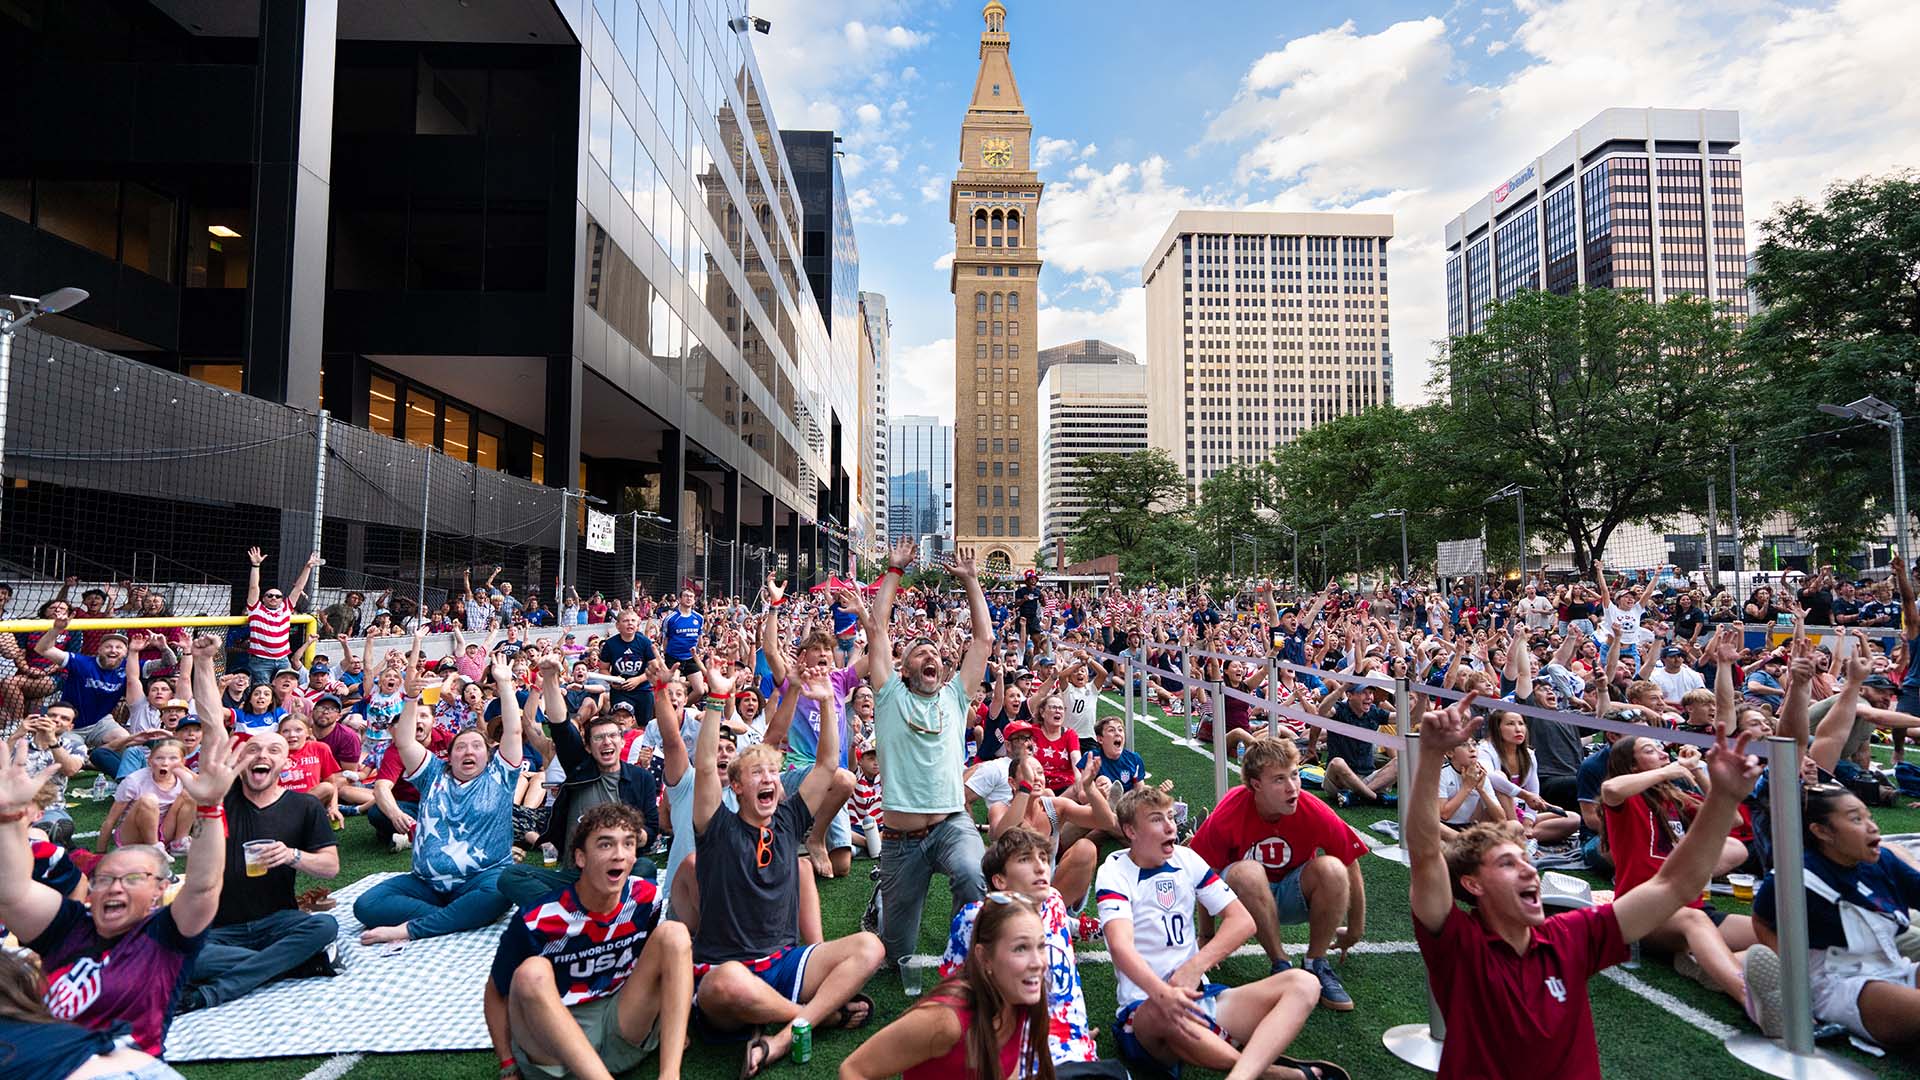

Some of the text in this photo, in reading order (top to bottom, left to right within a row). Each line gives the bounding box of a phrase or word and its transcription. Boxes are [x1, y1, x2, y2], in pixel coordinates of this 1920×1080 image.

[615, 657, 643, 673] USA
[1072, 699, 1085, 713] 10
[300, 755, 320, 766] Hills
[1157, 883, 1173, 894] USA
[1162, 914, 1184, 947] 10
[554, 936, 635, 964] FIFA WORLD CUP
[570, 946, 633, 978] USA
